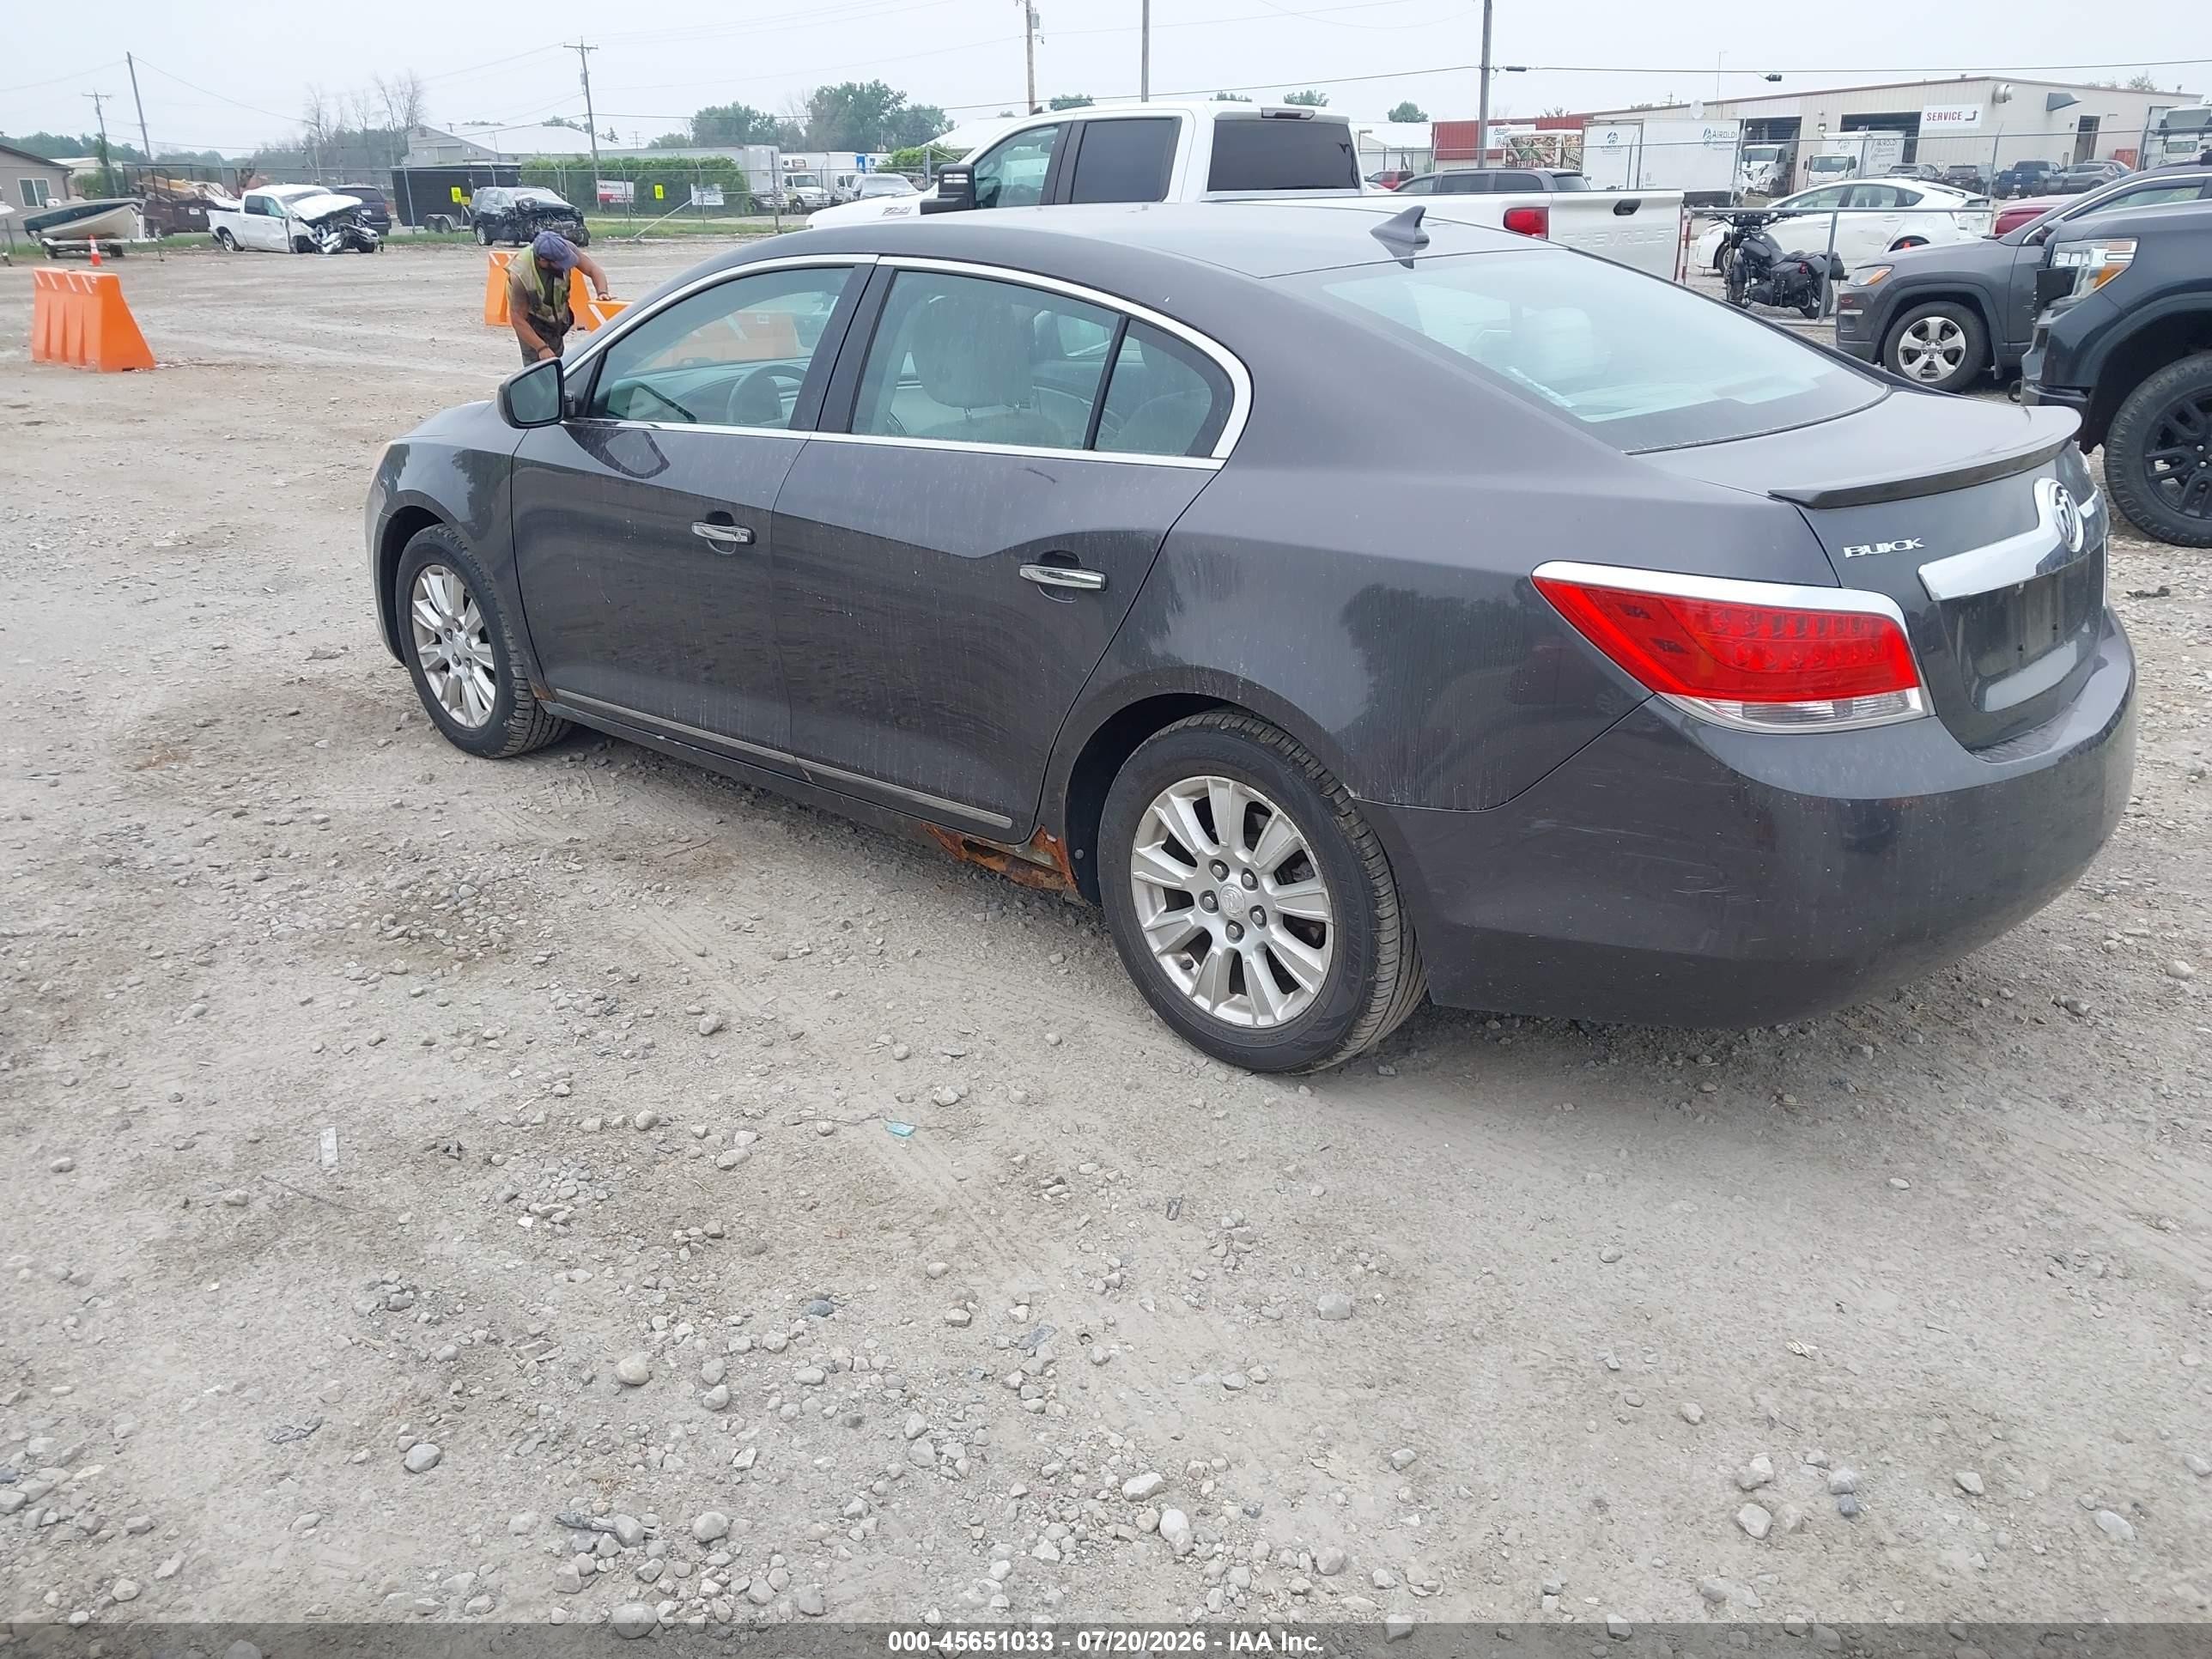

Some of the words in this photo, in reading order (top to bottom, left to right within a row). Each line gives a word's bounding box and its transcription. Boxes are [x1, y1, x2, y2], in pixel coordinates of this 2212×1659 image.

[1926, 111, 1963, 121] SERVICE
[1561, 228, 1675, 248] CHEVROLET
[1843, 538, 1925, 558] BUICK
